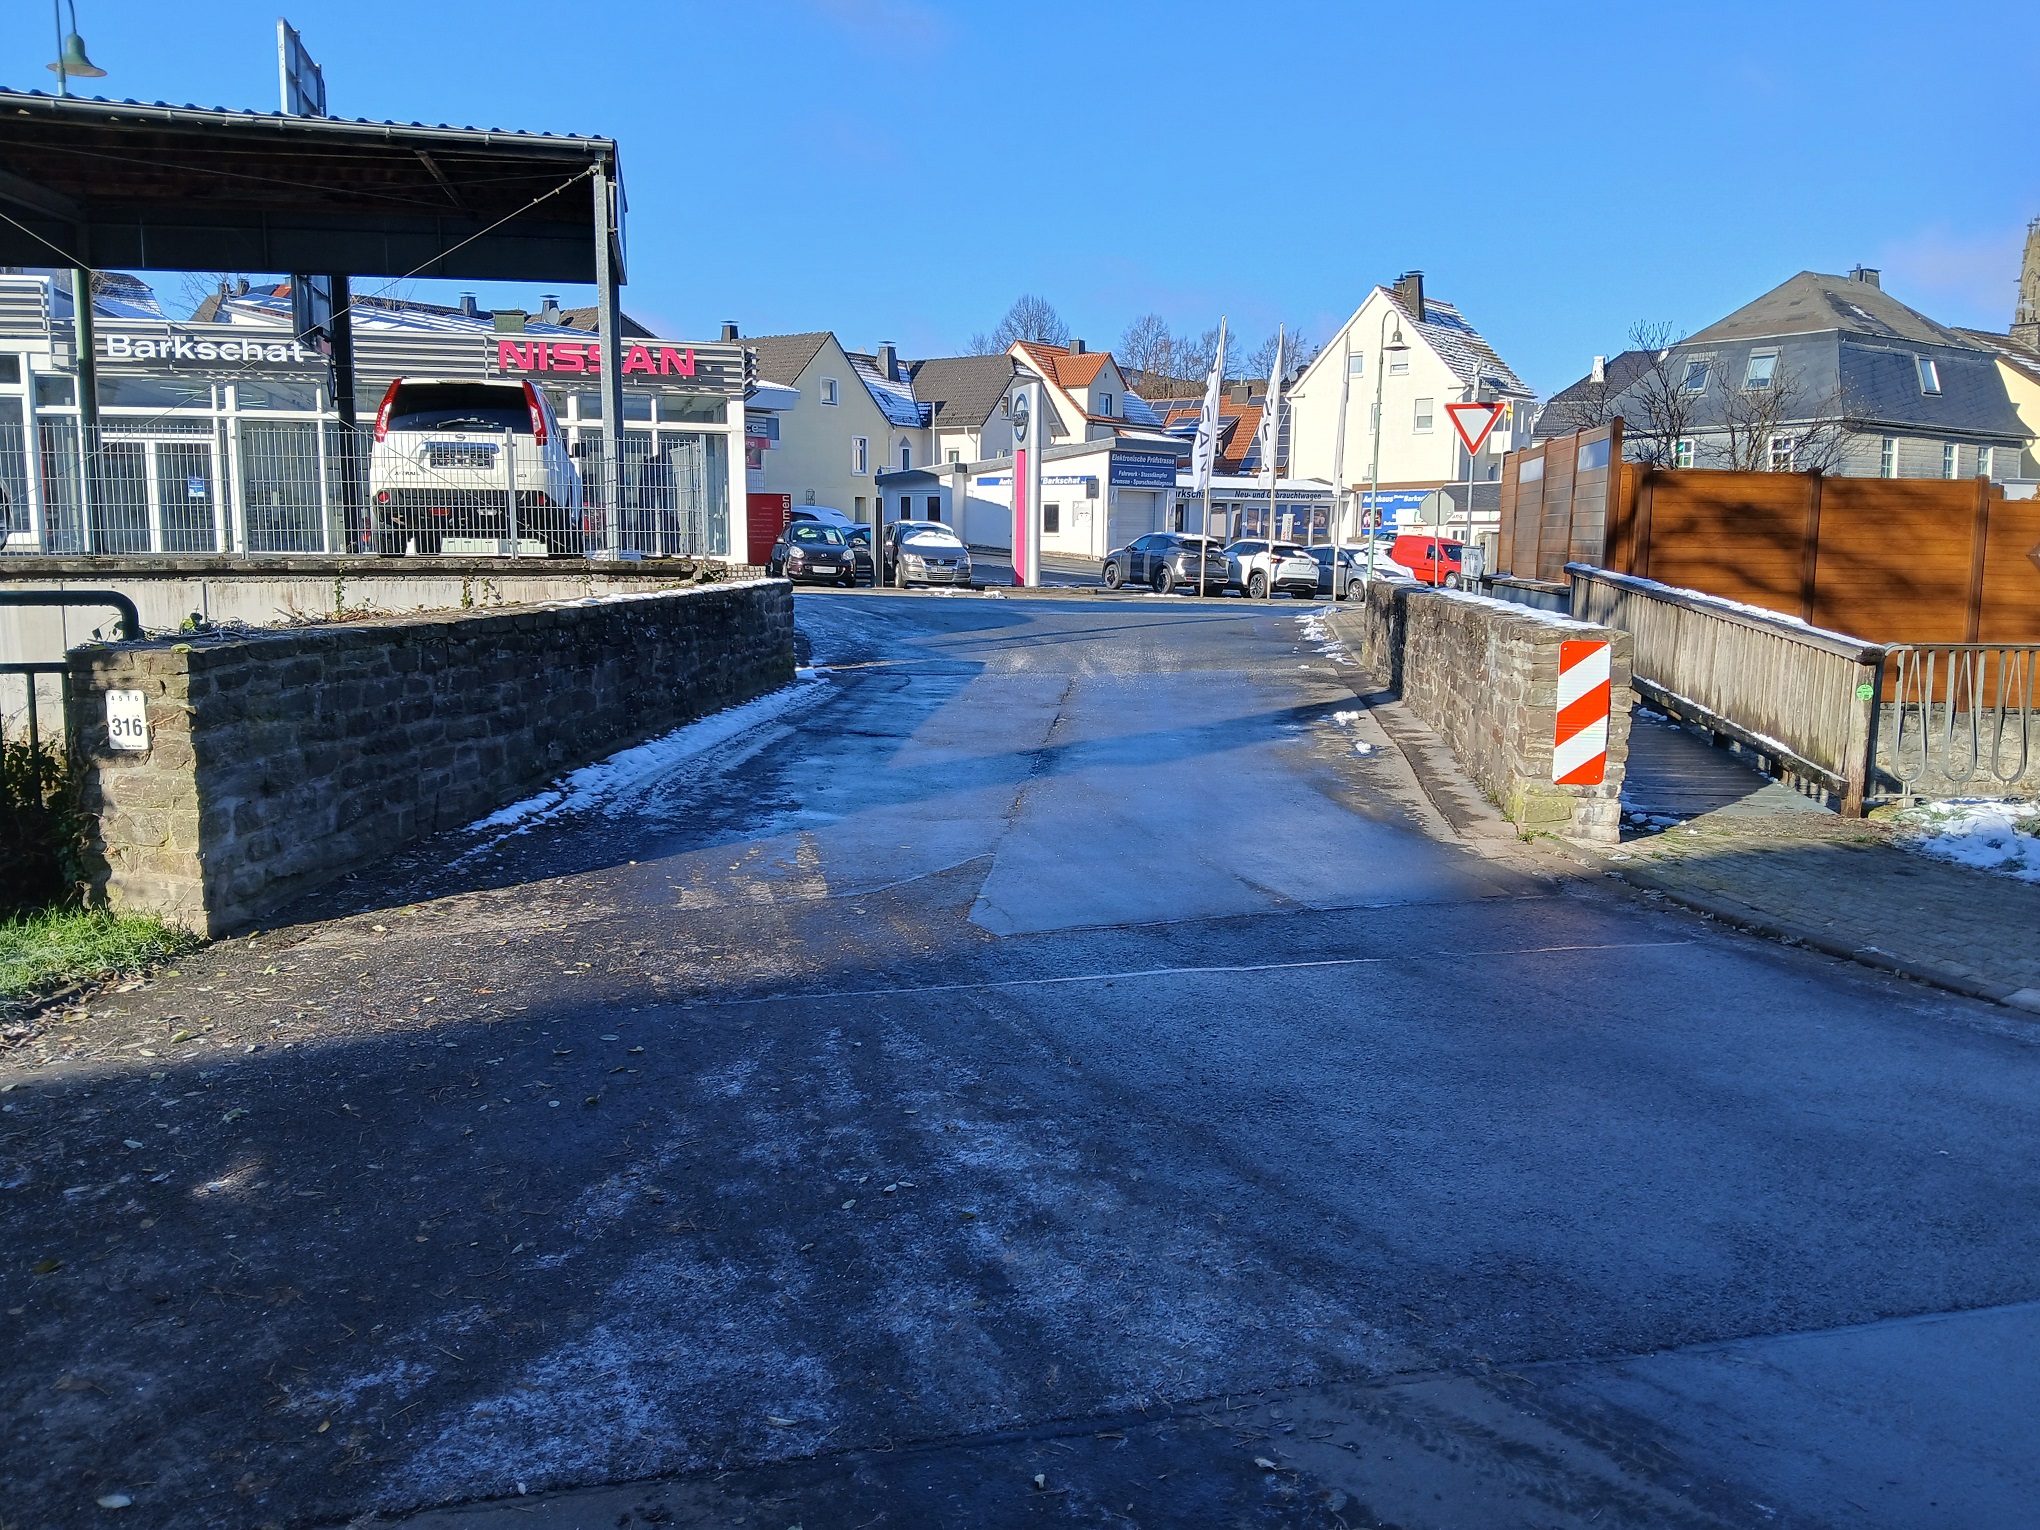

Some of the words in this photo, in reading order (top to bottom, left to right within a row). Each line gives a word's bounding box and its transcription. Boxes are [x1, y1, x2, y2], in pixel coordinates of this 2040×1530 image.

[106, 334, 305, 363] Barkschat
[1252, 491, 1265, 499] und
[1266, 491, 1322, 501] Gbrauchtwagen
[112, 718, 142, 736] 316
